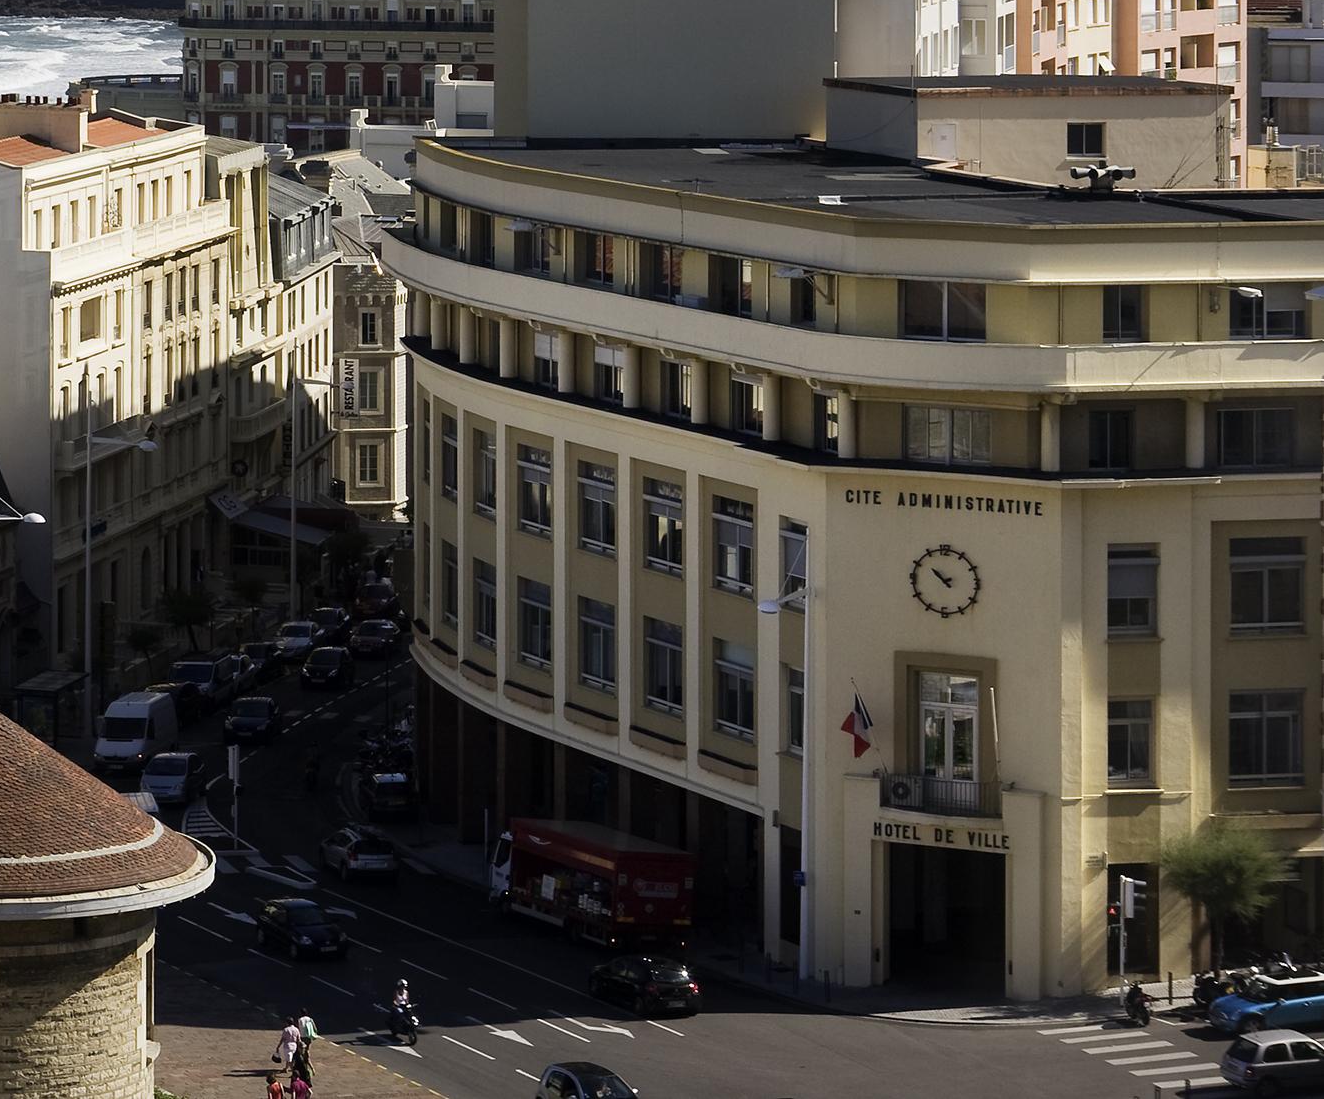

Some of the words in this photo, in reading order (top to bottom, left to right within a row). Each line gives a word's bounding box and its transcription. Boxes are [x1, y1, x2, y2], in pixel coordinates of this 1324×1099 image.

[344, 359, 355, 411] RESTARANT
[845, 489, 882, 505] CITE
[897, 492, 1043, 516] ADMINISTRATIVE
[939, 544, 951, 556] 12
[873, 821, 921, 841] HOTEL
[934, 827, 954, 844] DE
[967, 831, 1010, 850] VILLE
